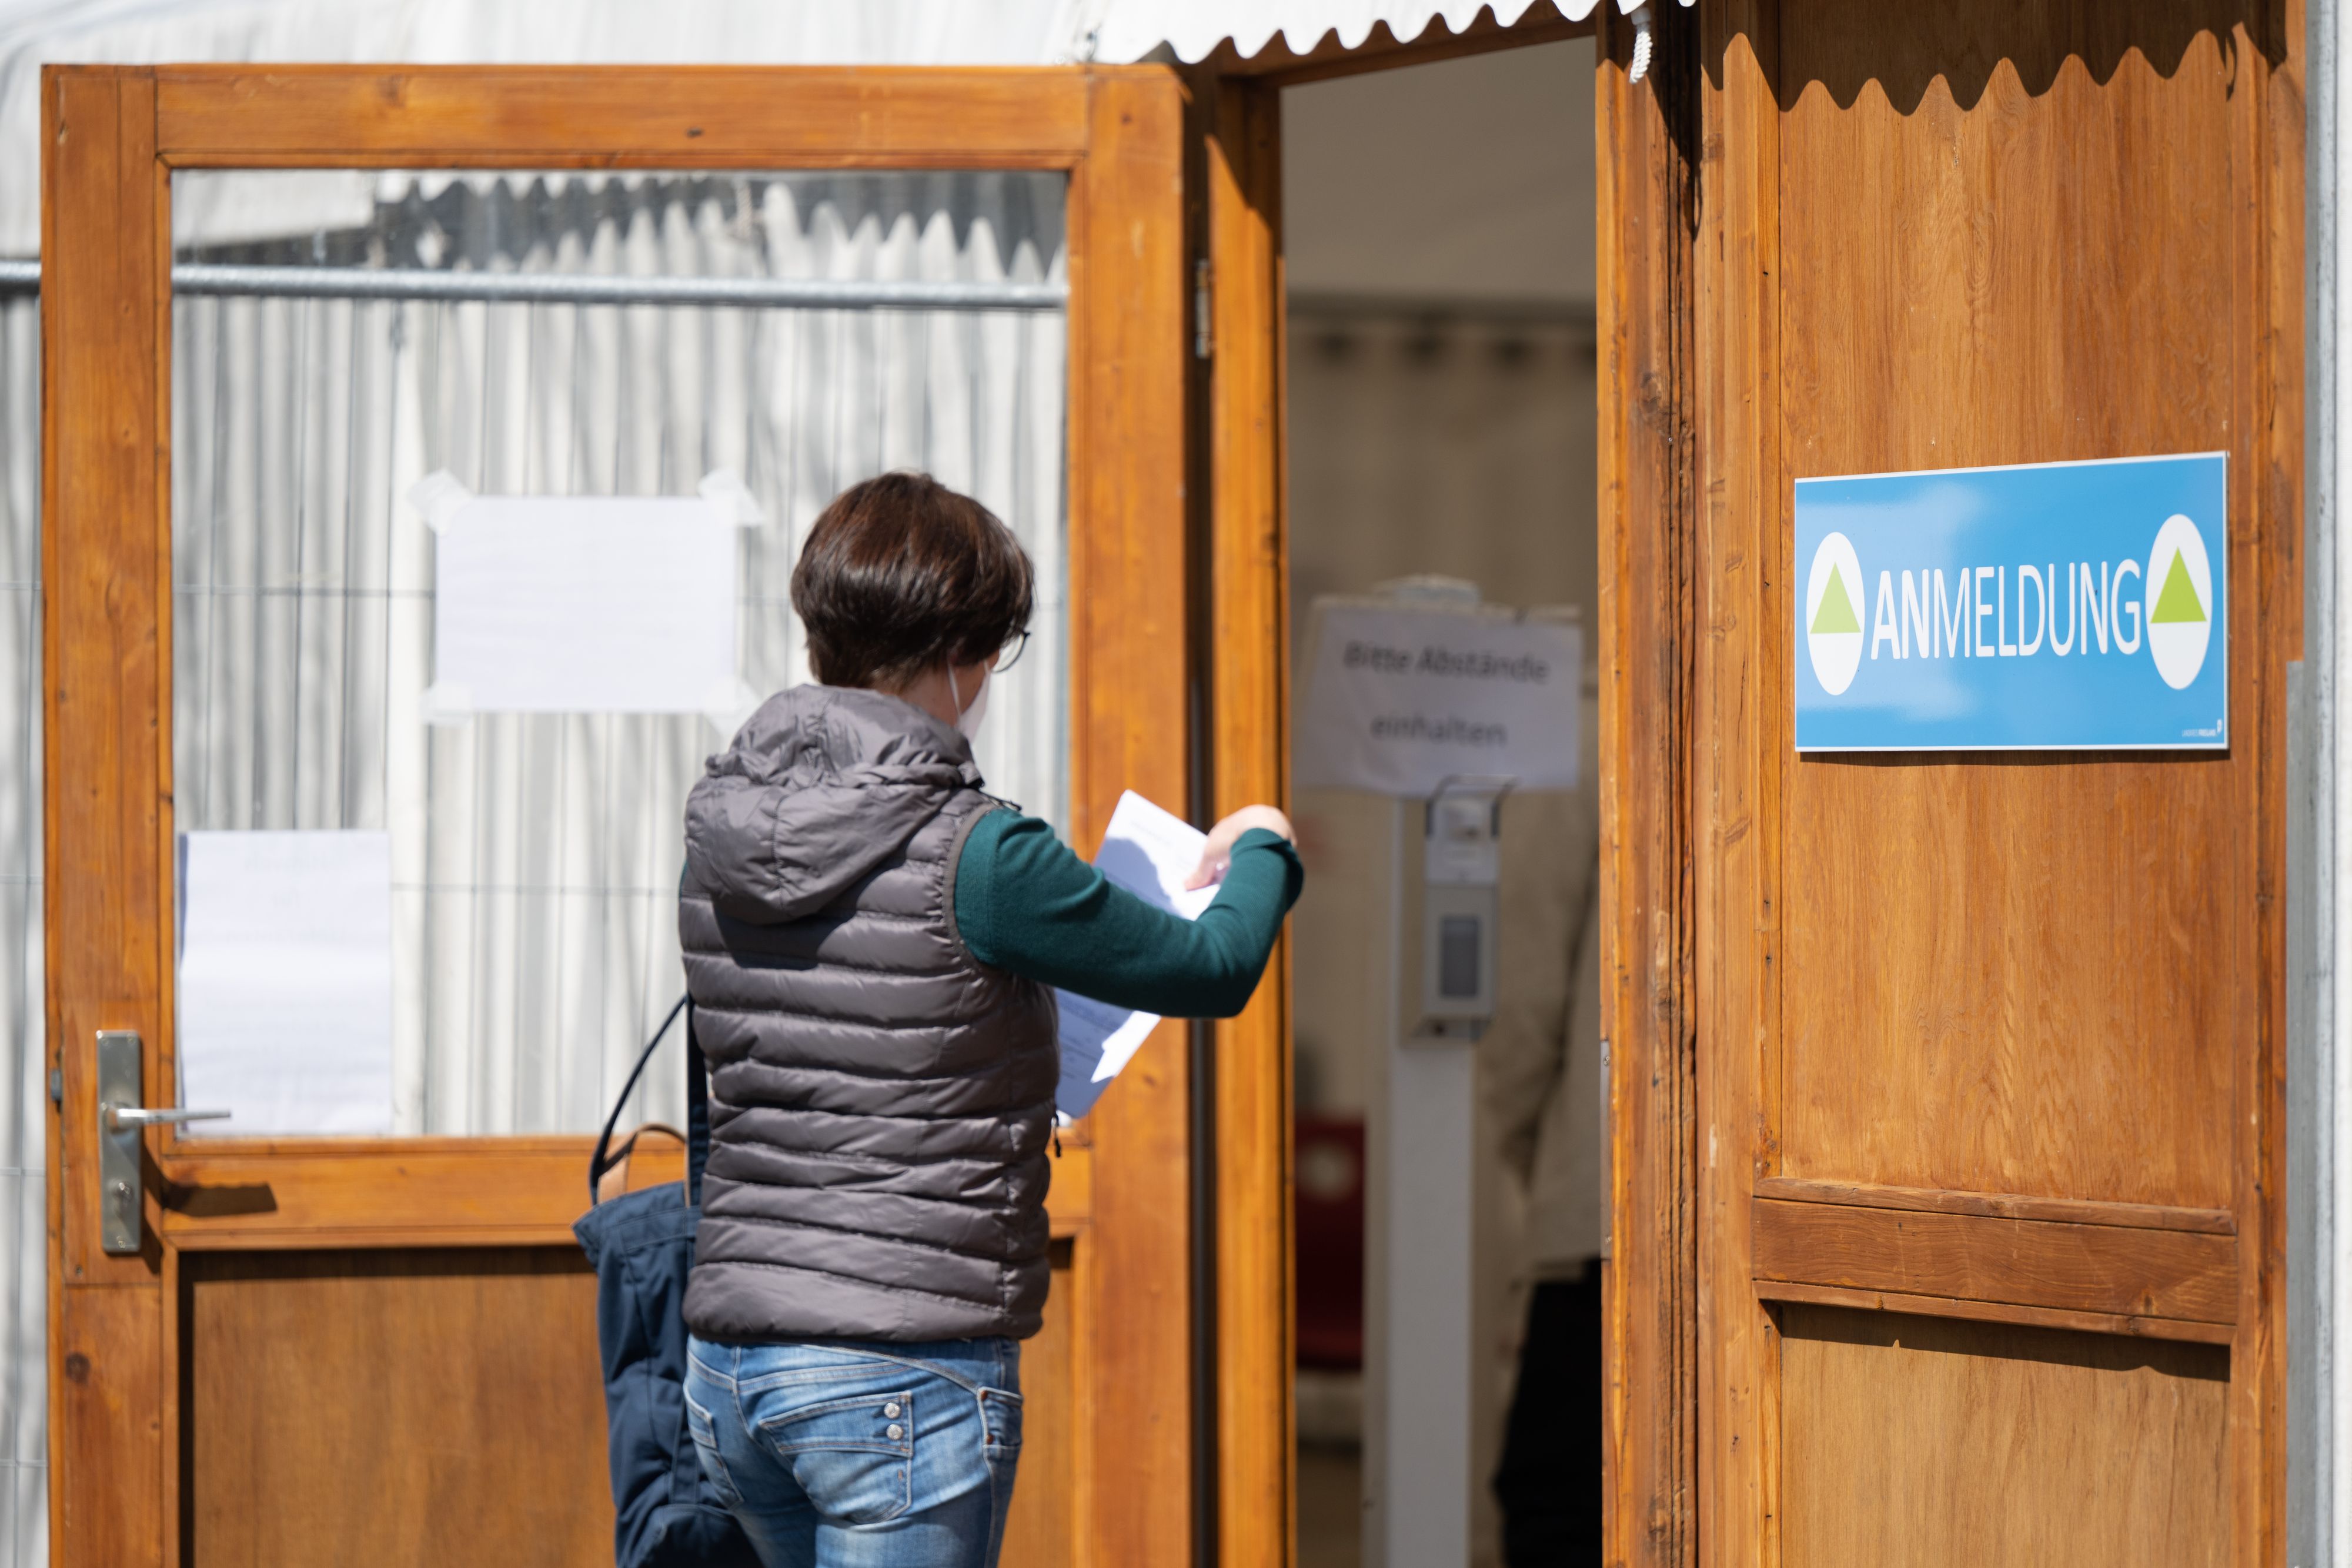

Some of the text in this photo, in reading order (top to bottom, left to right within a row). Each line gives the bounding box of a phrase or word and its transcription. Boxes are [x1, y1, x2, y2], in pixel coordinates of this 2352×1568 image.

[1870, 559, 2141, 660] ANMELDUNG
[1344, 641, 1550, 684] Bitte Abstände
[1371, 710, 1506, 747] einhalten
